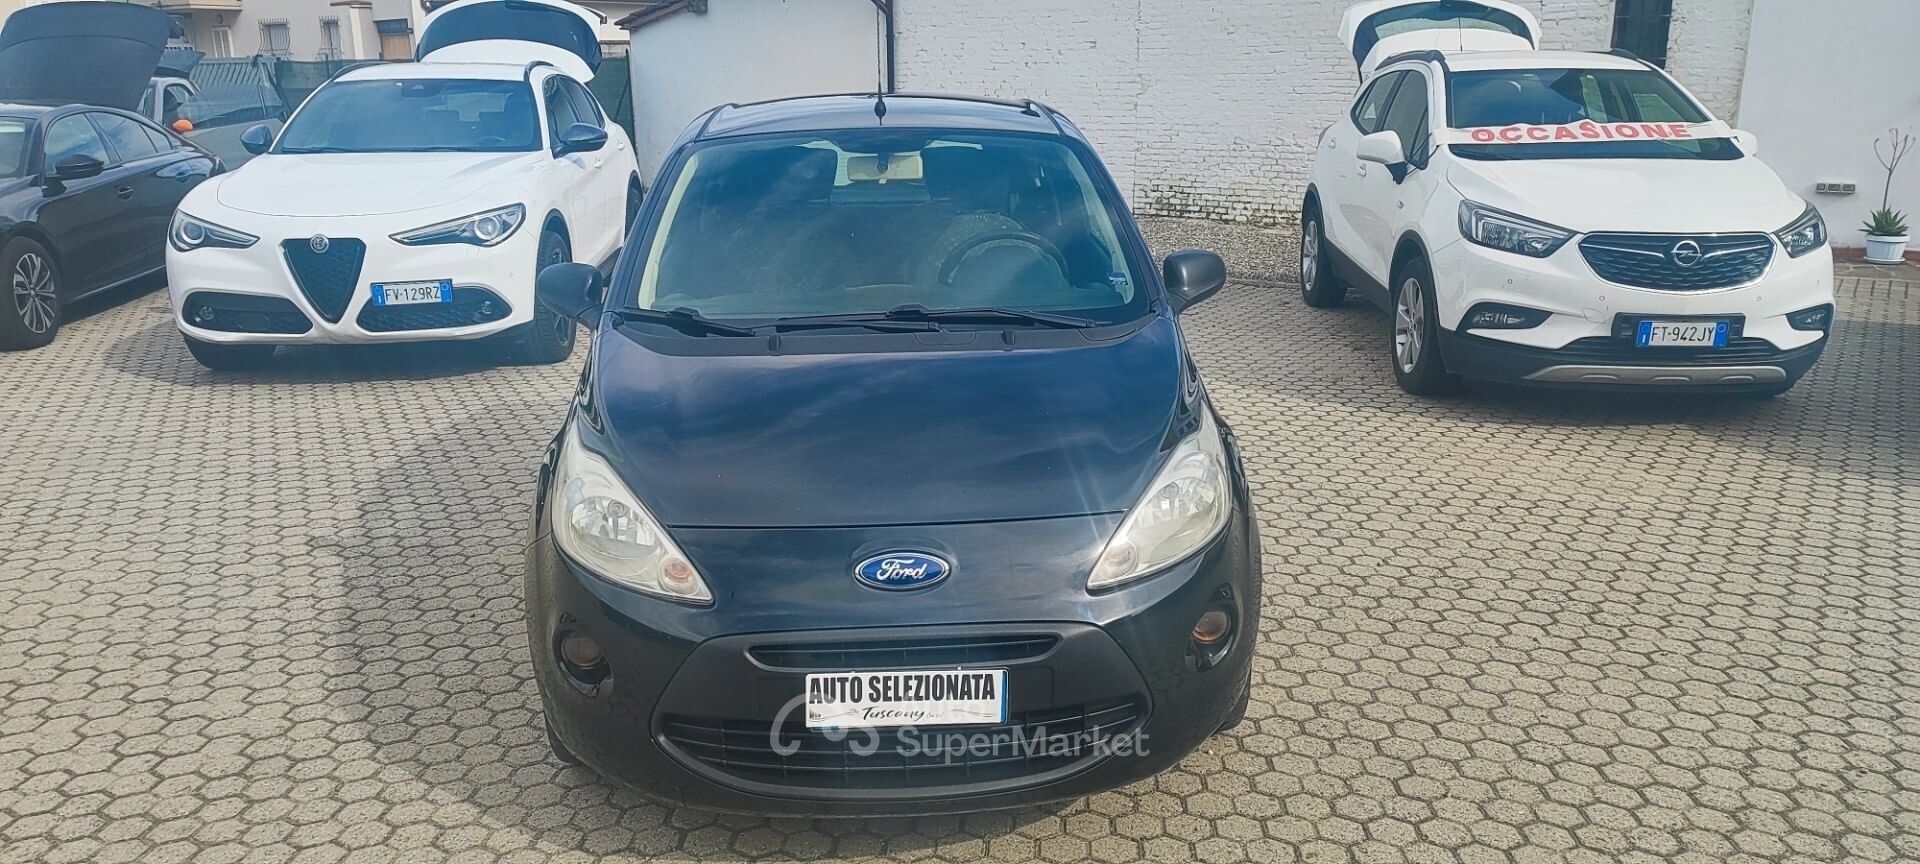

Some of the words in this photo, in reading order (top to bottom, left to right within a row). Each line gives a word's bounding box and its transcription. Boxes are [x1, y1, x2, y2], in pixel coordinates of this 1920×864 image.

[1471, 121, 1692, 143] OCCASIONE
[876, 558, 928, 580] Ford
[808, 676, 863, 704] AUTO
[868, 674, 996, 702] SELEZIONATA
